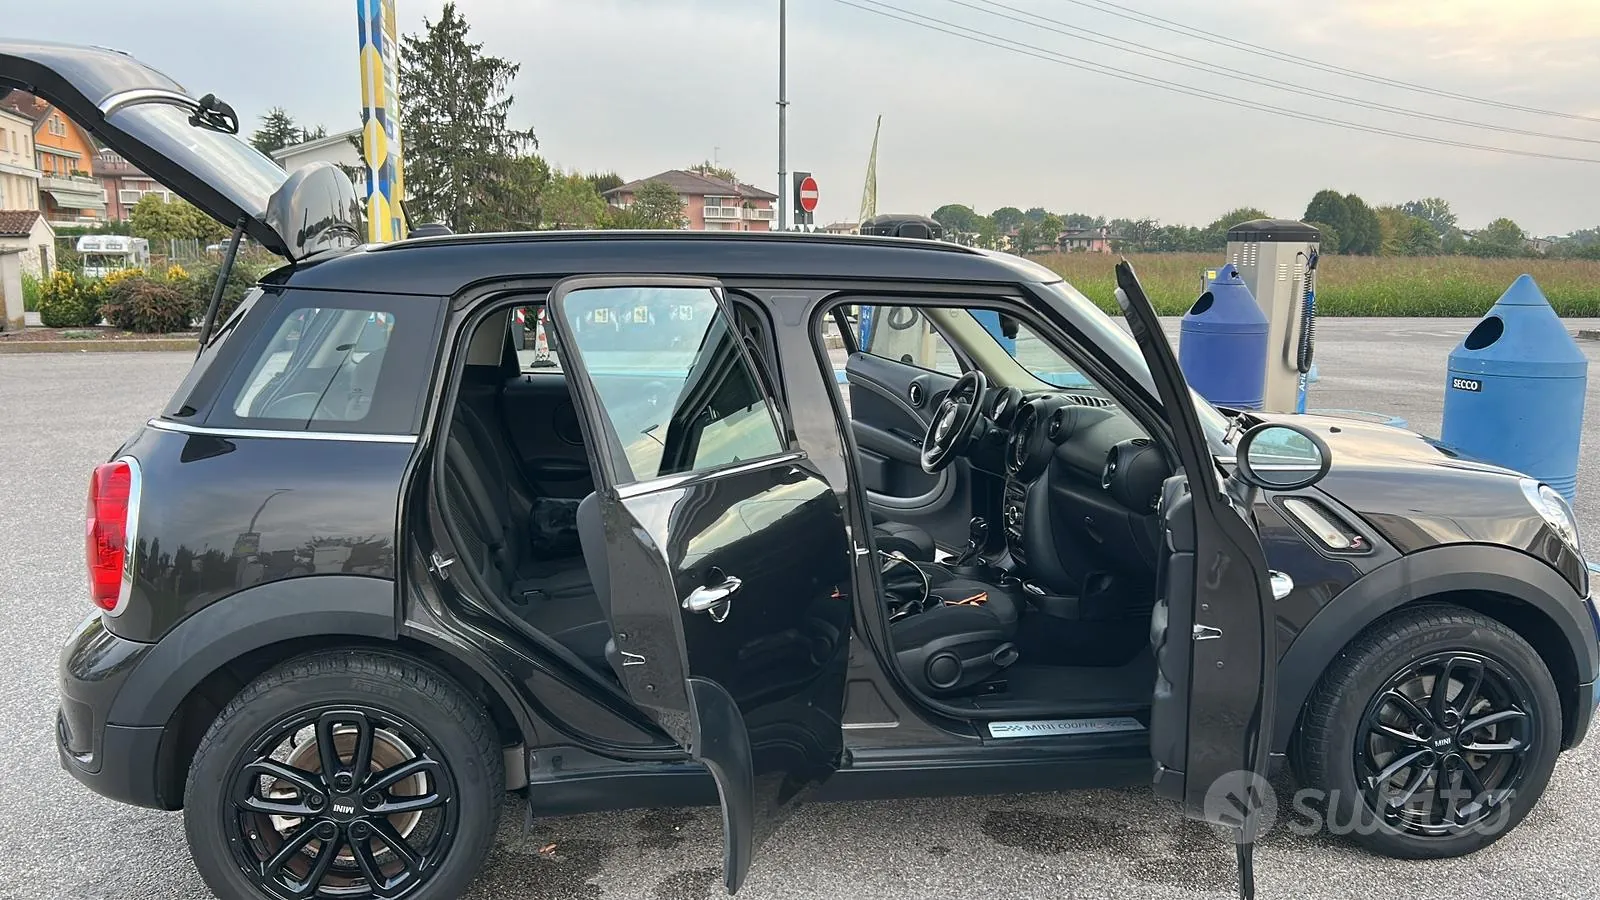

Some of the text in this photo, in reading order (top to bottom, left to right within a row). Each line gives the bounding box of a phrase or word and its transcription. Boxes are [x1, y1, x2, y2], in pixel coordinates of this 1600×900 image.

[1453, 379, 1478, 390] SECCO
[1350, 535, 1362, 549] S
[1025, 723, 1055, 732] MINI
[1434, 737, 1451, 747] MINI
[333, 804, 355, 814] MINI
